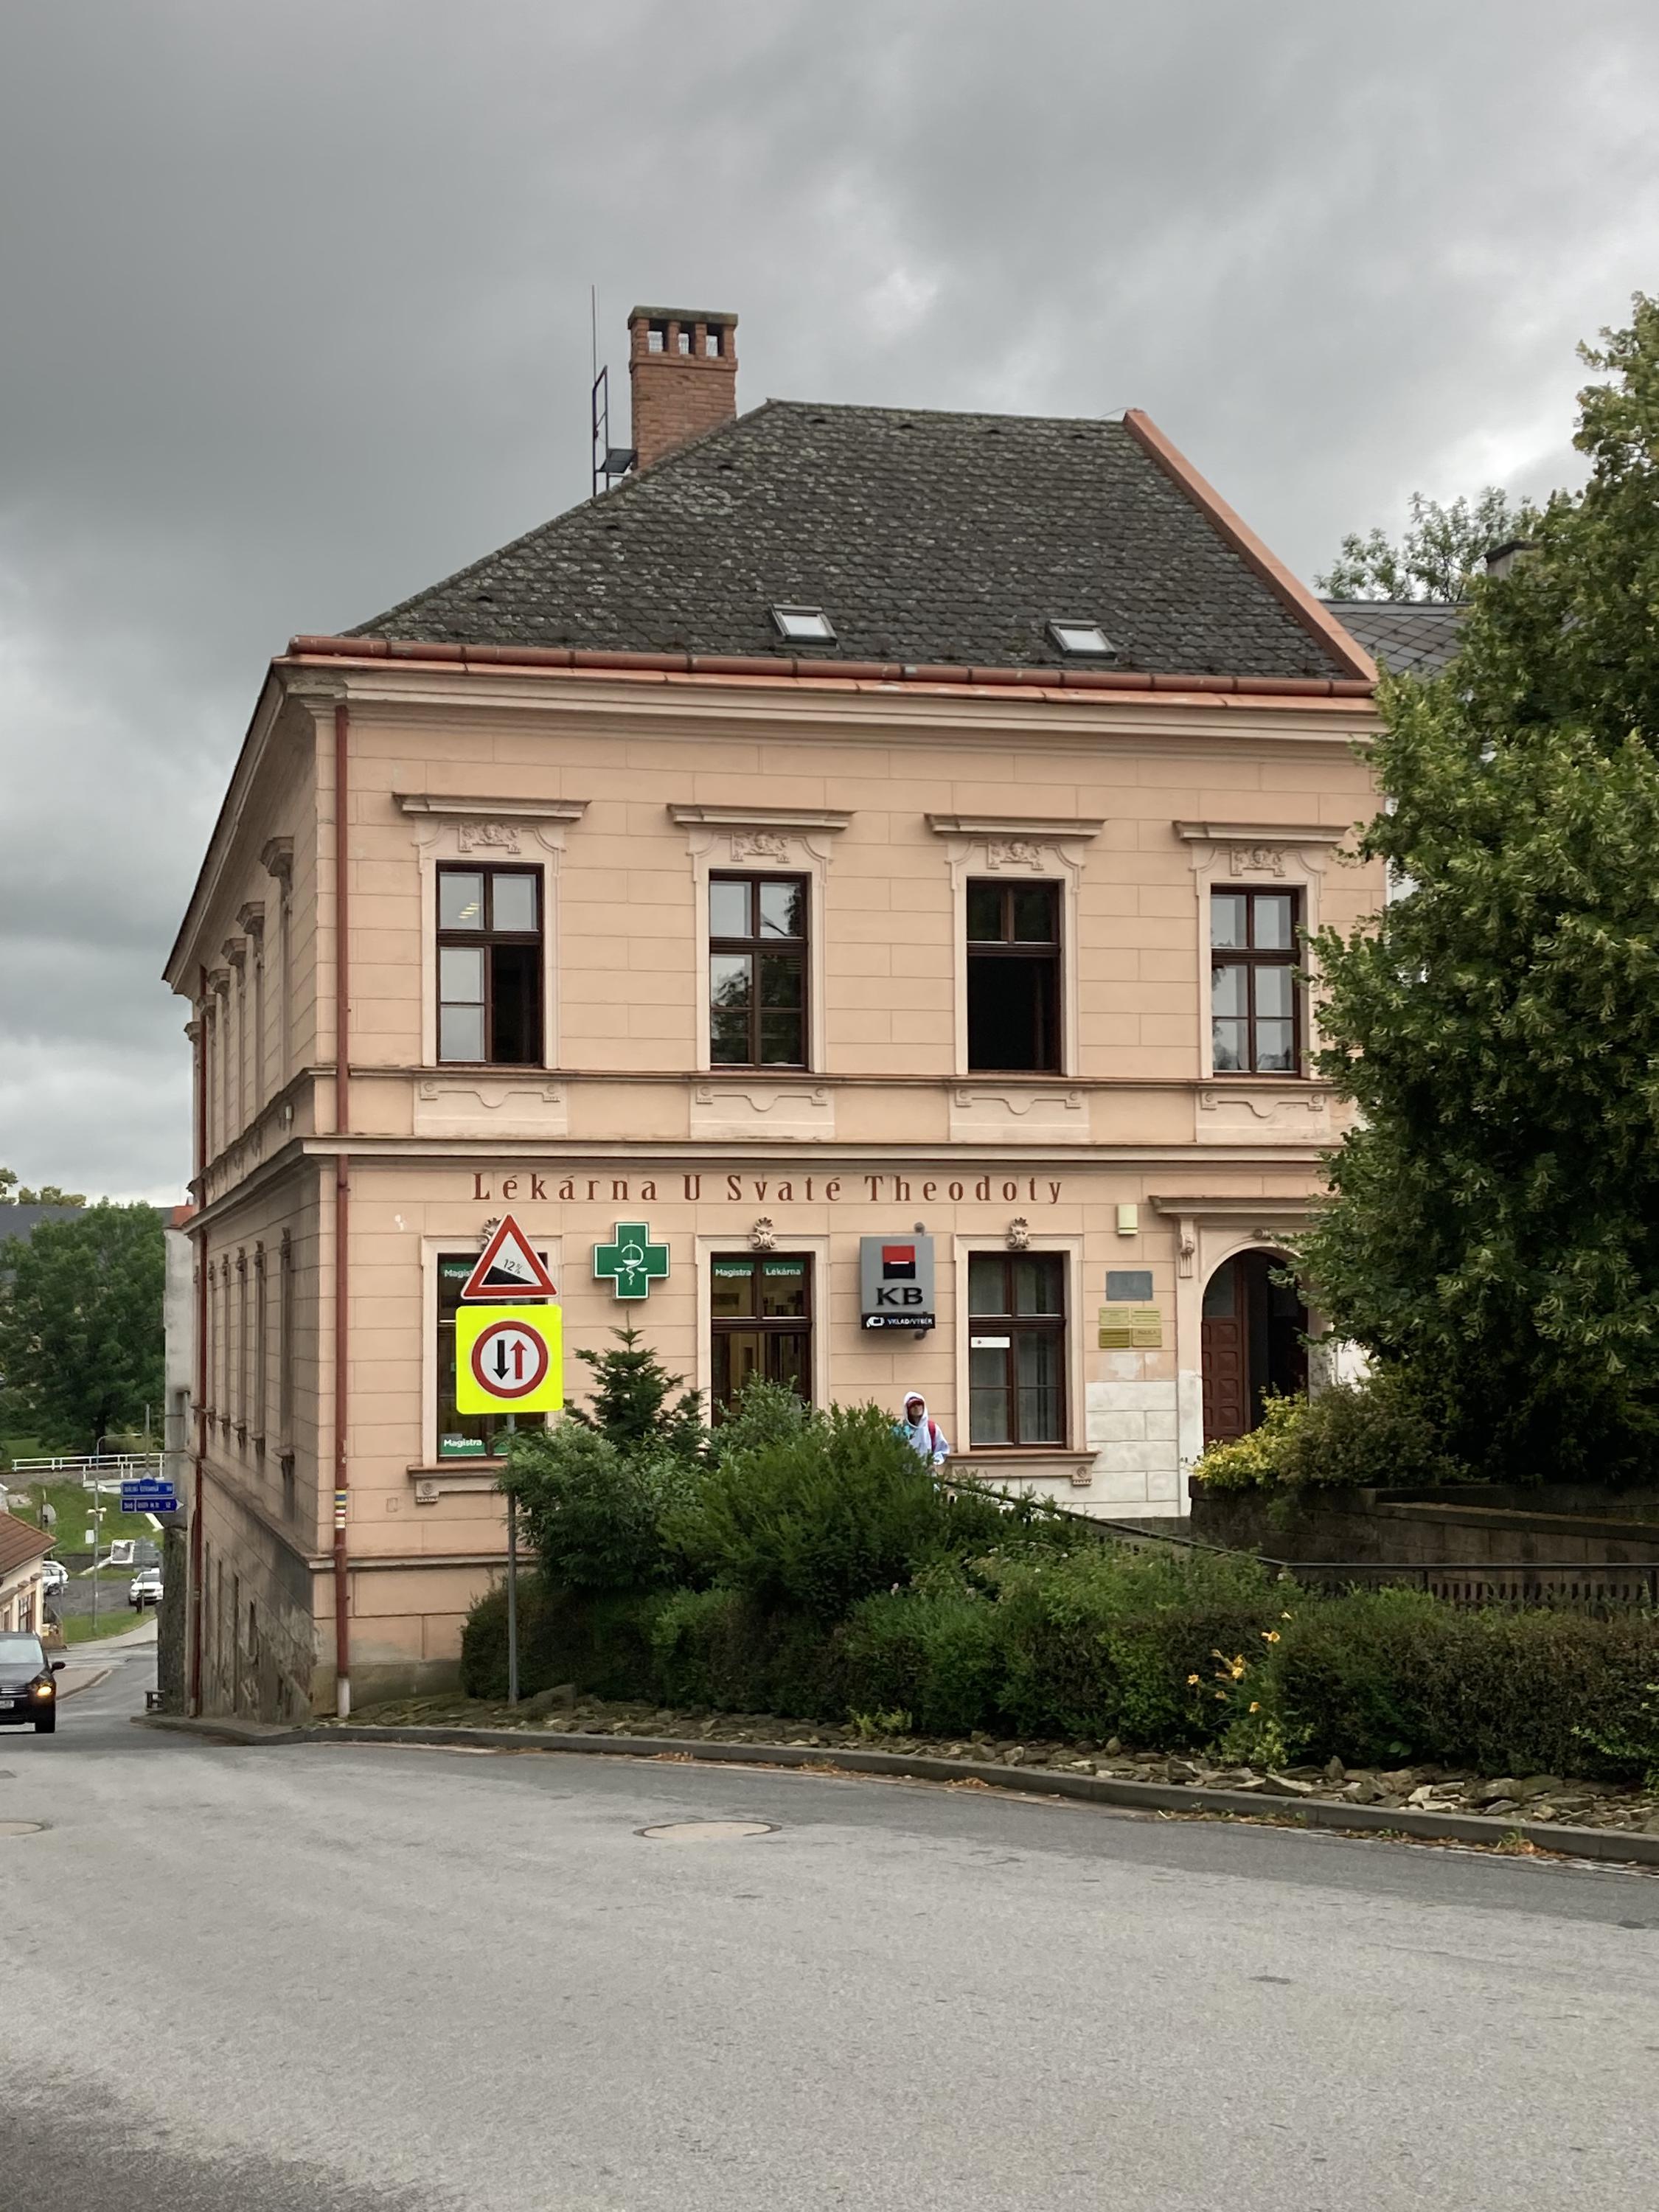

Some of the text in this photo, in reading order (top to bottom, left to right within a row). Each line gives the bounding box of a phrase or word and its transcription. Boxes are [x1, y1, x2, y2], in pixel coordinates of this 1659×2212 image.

[472, 1172, 1062, 1204] Lékárna U Svaté Theodoty
[503, 1259, 523, 1275] 12%
[715, 1268, 751, 1277] Magistra
[765, 1267, 801, 1276] Lékárna
[876, 1287, 923, 1306] KB
[444, 1439, 483, 1447] Magistra
